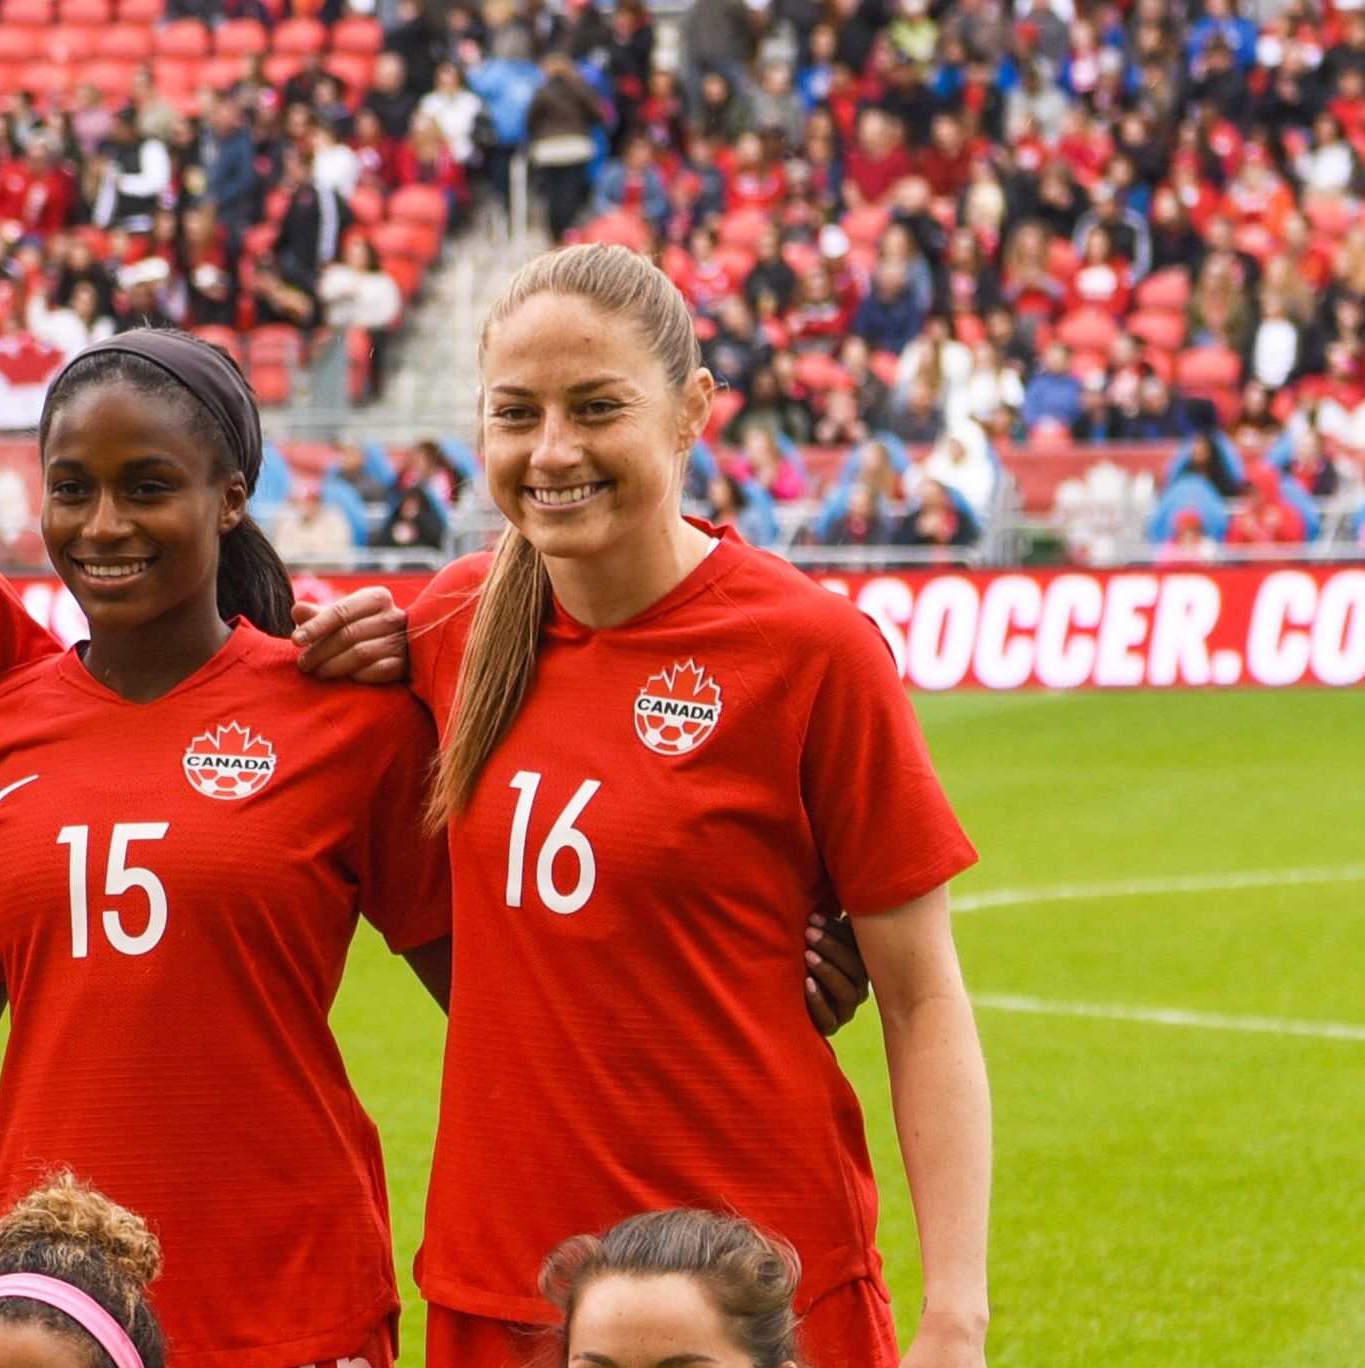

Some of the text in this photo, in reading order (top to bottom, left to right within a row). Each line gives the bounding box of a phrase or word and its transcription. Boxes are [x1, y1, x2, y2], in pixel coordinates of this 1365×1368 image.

[821, 570, 1365, 690] SOCCER.CO
[186, 756, 270, 770] CANADA
[638, 698, 714, 721] CANADA
[56, 822, 169, 958] 15
[505, 771, 601, 914] 16
